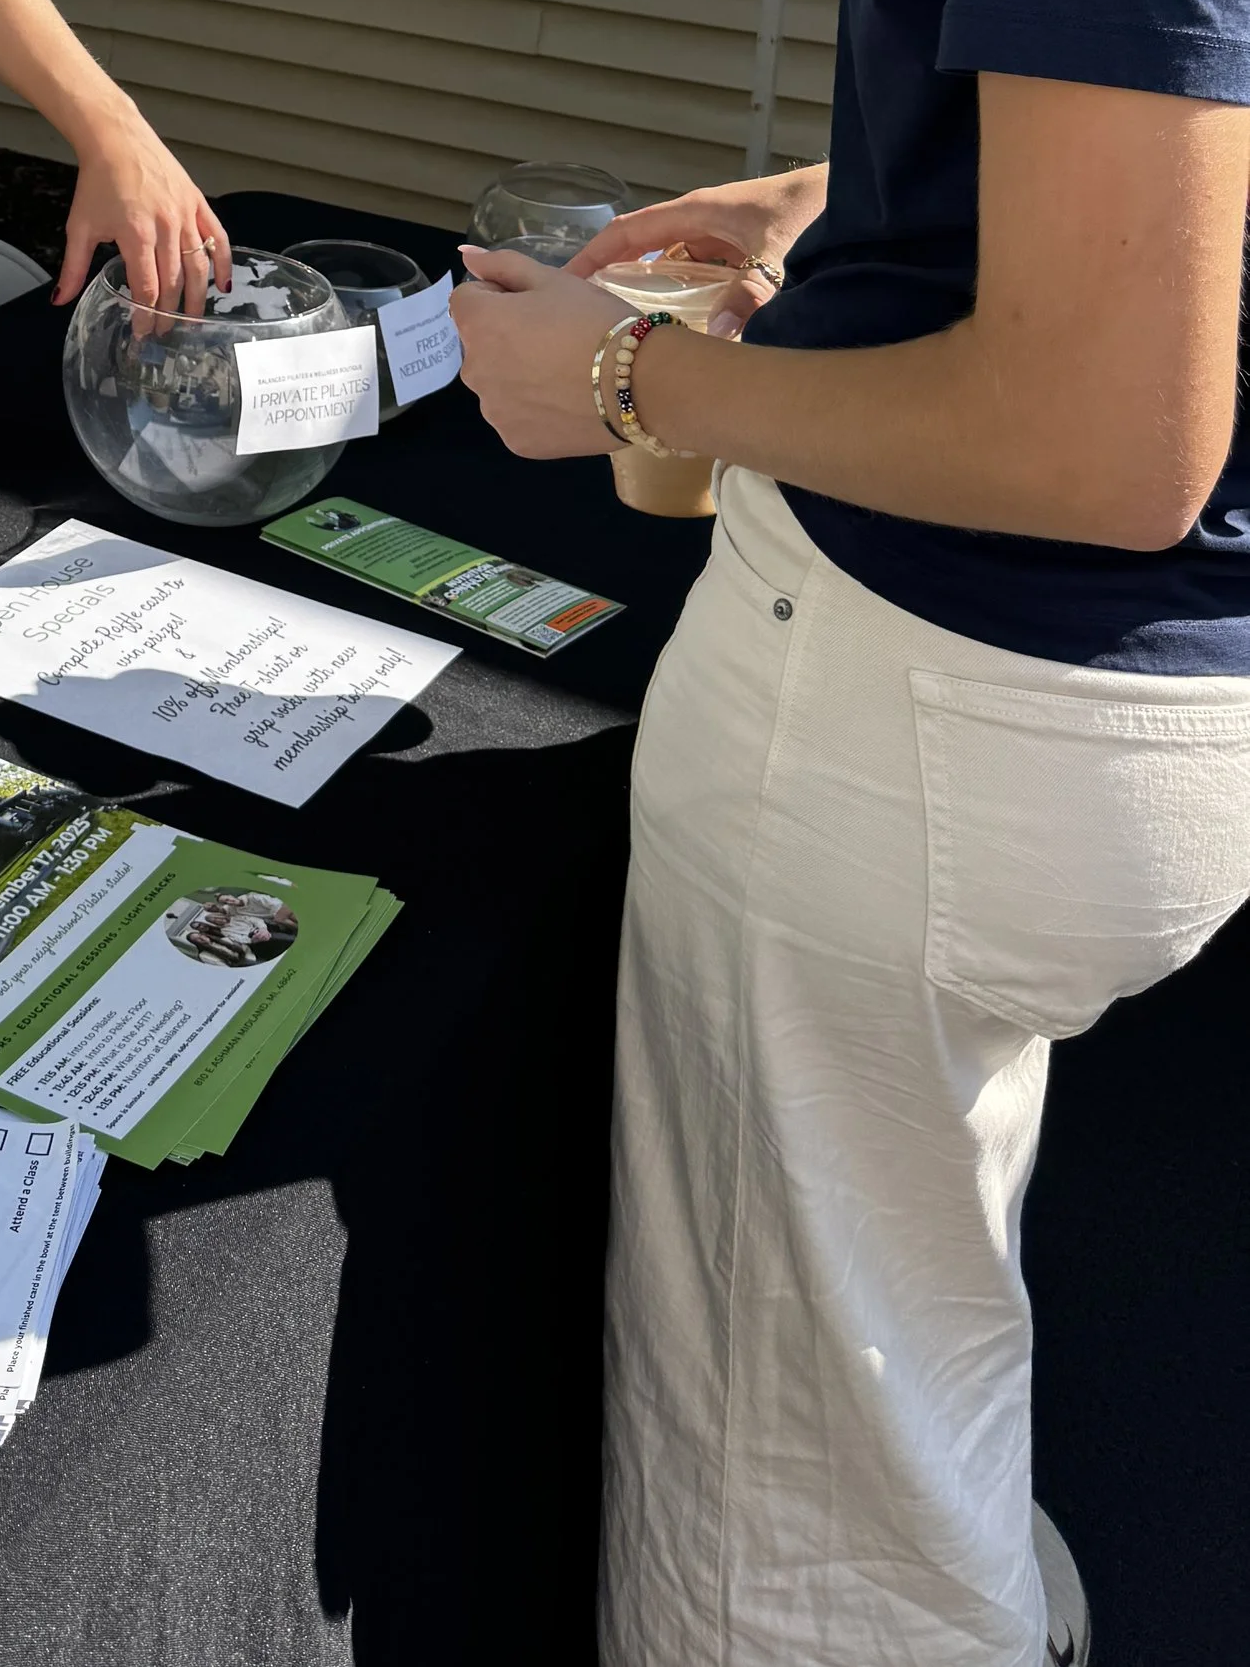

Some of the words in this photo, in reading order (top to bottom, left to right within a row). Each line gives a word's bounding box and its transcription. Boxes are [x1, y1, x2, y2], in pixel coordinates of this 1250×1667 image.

[399, 350, 443, 379] NEEDLING
[416, 332, 440, 353] FREE
[260, 386, 318, 408] PRIVATE
[321, 377, 371, 399] PILATES
[264, 400, 355, 425] APPOINTMENT
[18, 557, 94, 601] House
[23, 584, 115, 642] Specials
[36, 629, 103, 685] Complete
[96, 611, 142, 640] Raffle
[139, 581, 171, 610] card
[164, 579, 184, 589] to
[116, 648, 145, 666] win
[142, 612, 186, 653] prizes!
[175, 647, 196, 659] &
[200, 615, 288, 685] Memberships!
[184, 670, 219, 698] off
[209, 682, 251, 716] Free
[241, 654, 292, 690] T-shirt
[288, 645, 308, 657] or
[243, 718, 281, 747] grip
[270, 694, 307, 718] socks
[302, 668, 334, 692] with
[330, 646, 356, 668] new
[151, 695, 188, 722] 10%
[273, 703, 355, 771] membership
[339, 676, 389, 705] today
[376, 647, 413, 683] only!
[32, 849, 62, 867] 17,
[52, 817, 91, 848] 2025
[25, 880, 56, 908] AM
[55, 849, 89, 875] 1:30
[82, 827, 113, 850] PM
[10, 962, 32, 984] your
[31, 912, 83, 957] neighborhood
[76, 888, 108, 915] Pilates
[105, 861, 132, 888] studio!
[15, 973, 78, 1030] EDUCATIONAL
[75, 932, 117, 971] SESSIONS
[120, 901, 146, 925] LIGHT
[143, 872, 176, 902] SNACKS
[5, 1066, 30, 1086] FREE
[25, 1026, 70, 1068] Educational
[66, 996, 101, 1028] Sessions:
[37, 1070, 56, 1085] 11:15
[54, 1056, 71, 1071] AM:
[66, 1039, 87, 1056] Intro
[83, 1032, 95, 1040] to
[90, 1010, 117, 1033] Pilates
[51, 1074, 73, 1091] 11:45
[70, 1060, 88, 1076] AM:
[84, 1042, 105, 1059] Intro
[101, 1034, 113, 1043] to
[108, 1014, 132, 1035] Pelvic
[80, 1085, 103, 1103] 12:45
[98, 1071, 117, 1086] PM:
[112, 1052, 136, 1071] What
[136, 1032, 155, 1046] Dry
[148, 999, 183, 1033] Needling?
[95, 1097, 112, 1110] 1:15
[108, 1083, 126, 1098] PM:
[122, 1053, 155, 1084] Nutrition
[151, 1044, 163, 1053] at
[157, 1012, 191, 1045] Balanced
[66, 1080, 87, 1097] 12:15
[82, 1067, 101, 1082] PM:
[96, 1044, 120, 1067] What
[121, 1030, 137, 1042] the
[9, 1196, 28, 1233] Attend
[23, 1159, 39, 1186] Class
[55, 1166, 69, 1200] between
[48, 1217, 57, 1230] the
[51, 1201, 62, 1216] tent
[39, 1240, 51, 1258] bowl
[46, 1228, 53, 1239] at
[32, 1273, 41, 1281] in
[36, 1259, 46, 1272] the
[29, 1282, 39, 1299] card
[18, 1300, 34, 1330] finished
[6, 1350, 19, 1372] Place
[14, 1331, 25, 1349] your
